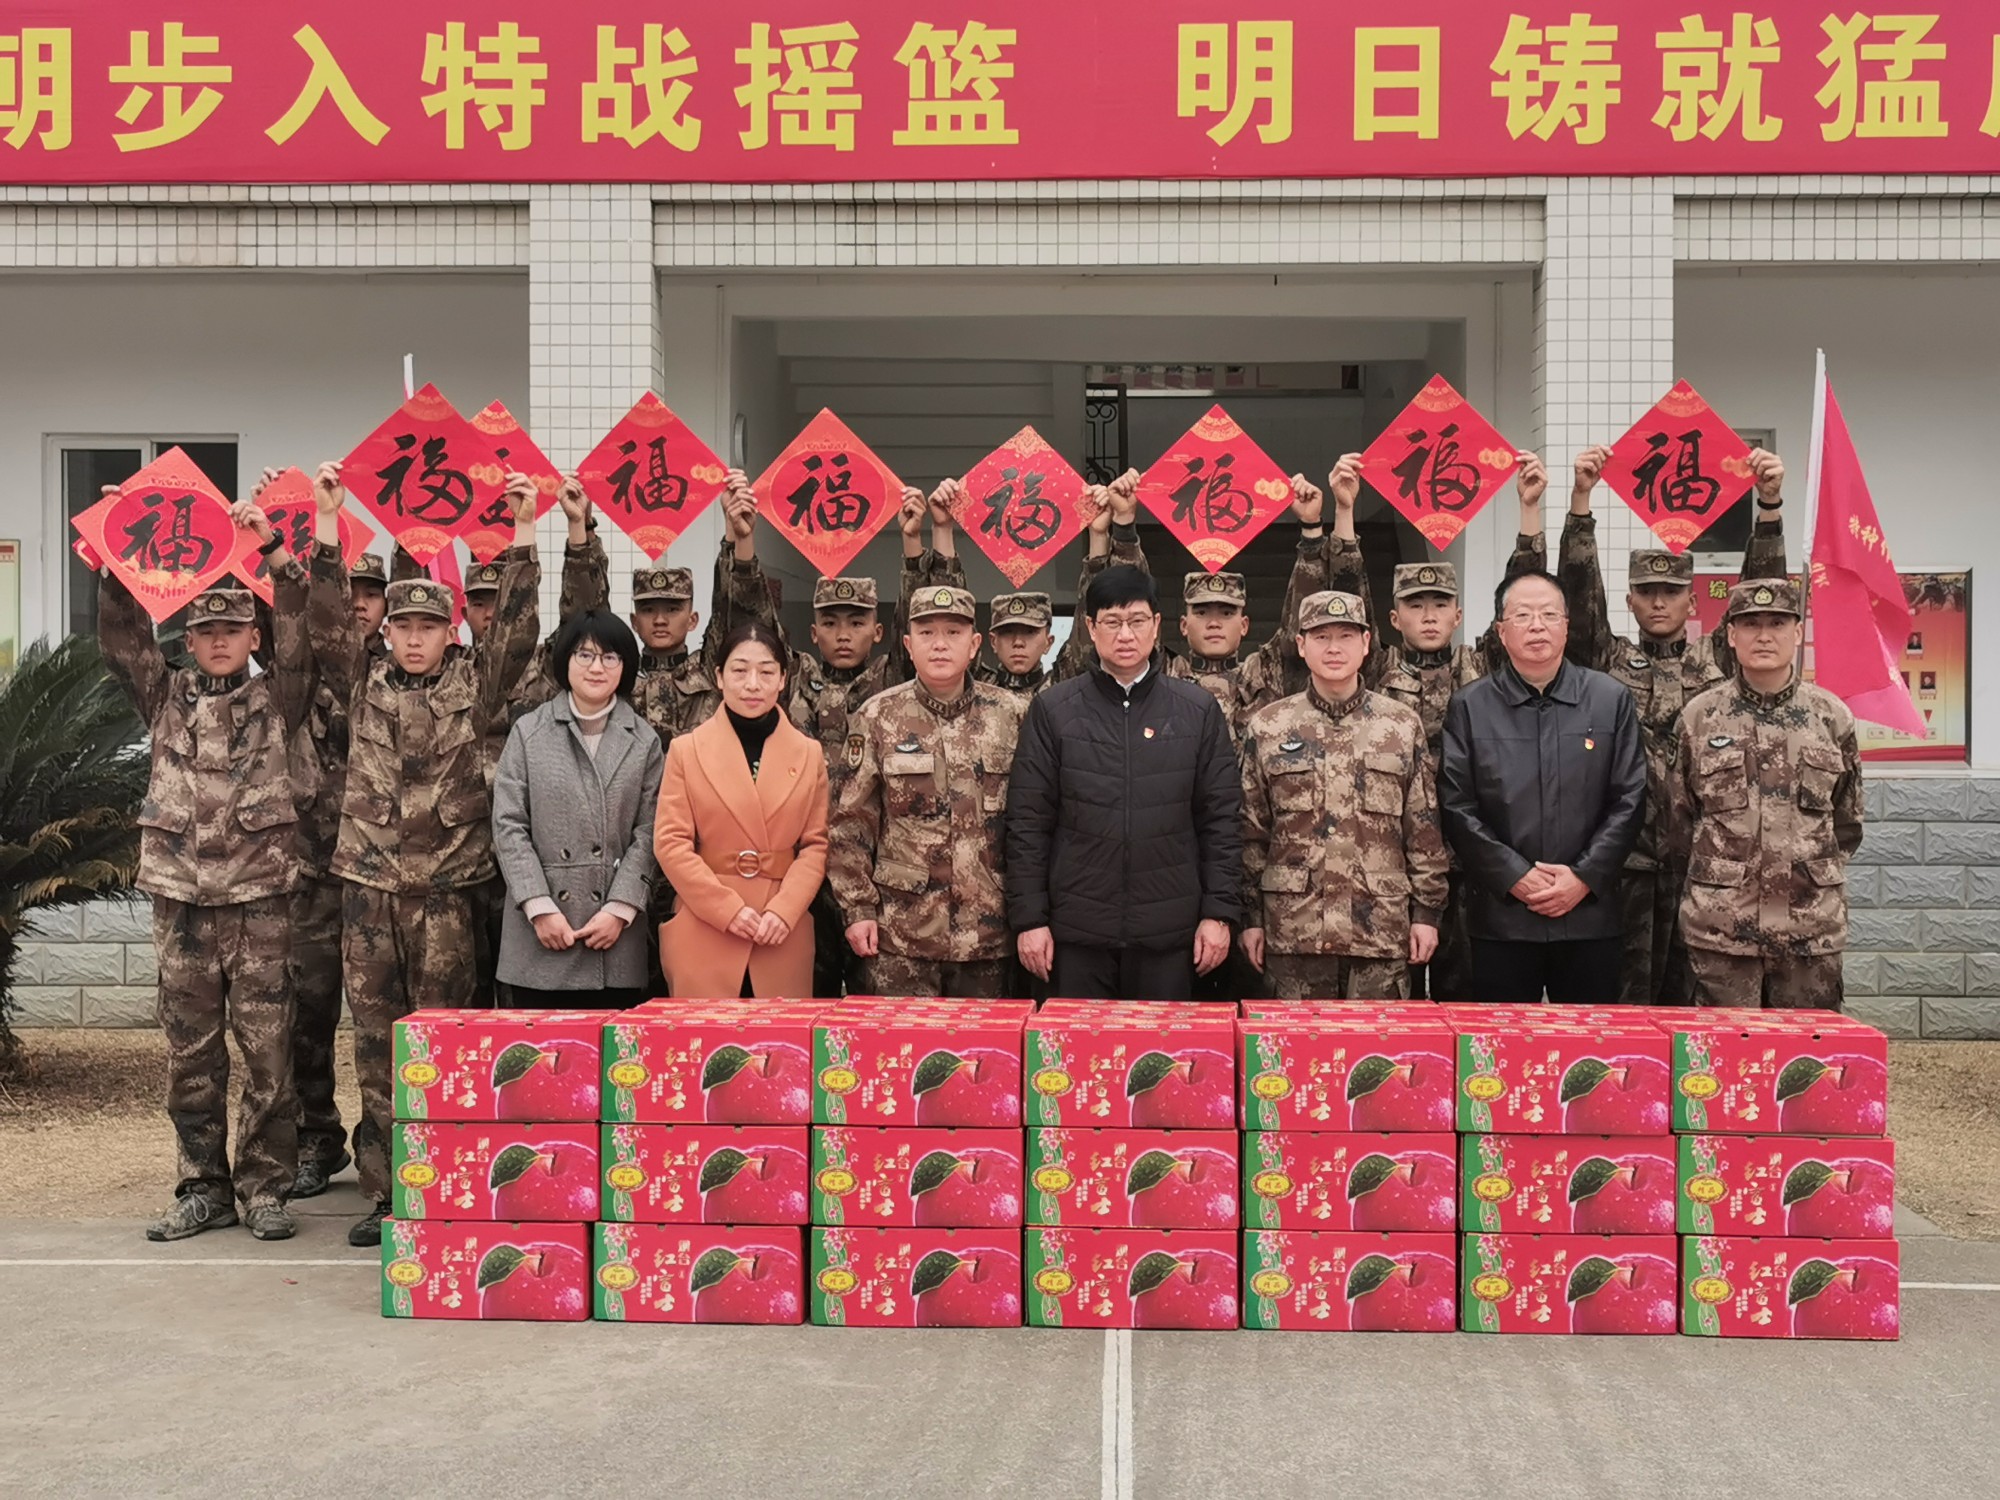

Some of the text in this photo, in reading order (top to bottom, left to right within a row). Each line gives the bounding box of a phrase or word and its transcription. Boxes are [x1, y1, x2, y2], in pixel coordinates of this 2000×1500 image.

[0, 10, 2000, 152] 朝步入特战摇篮 明日铸就猛
[375, 433, 475, 526] 福
[606, 435, 689, 513] 福
[785, 453, 872, 536] 福
[981, 465, 1063, 551] 福
[1169, 453, 1257, 535] 福
[1391, 422, 1482, 512] 福
[1631, 429, 1721, 516] 福
[120, 493, 215, 574] 福
